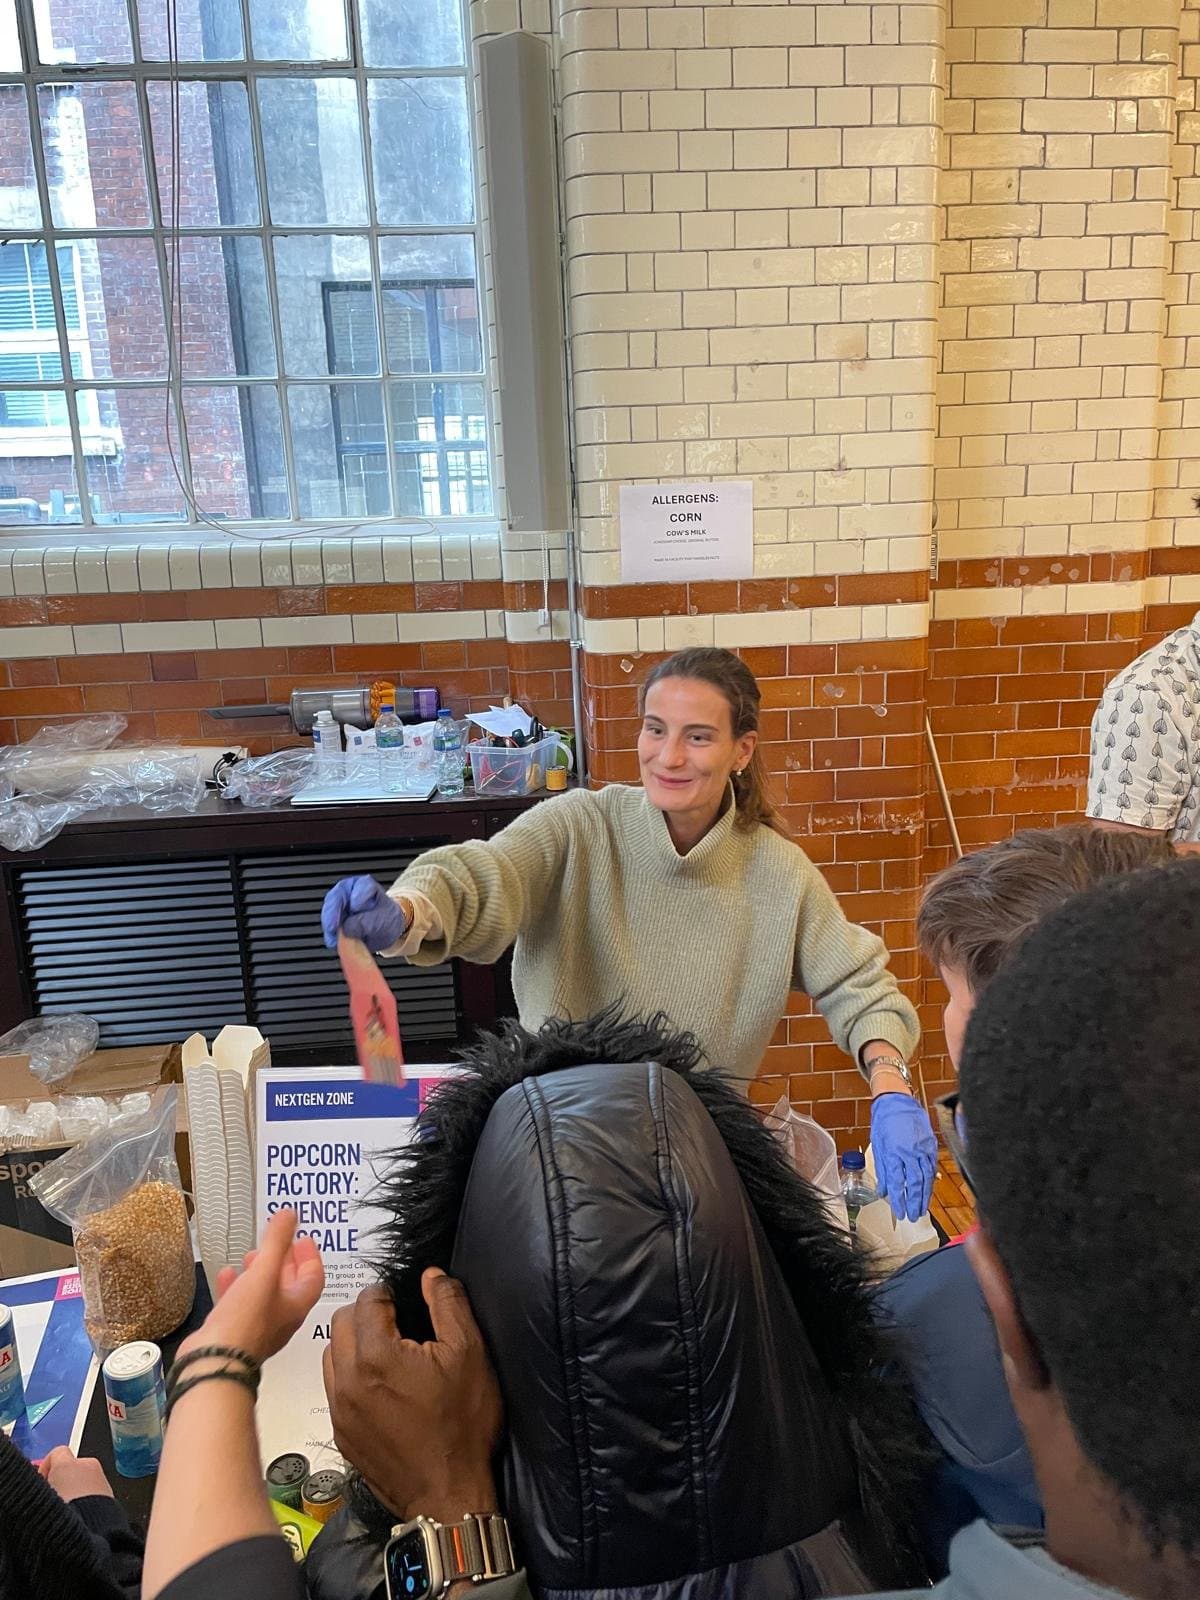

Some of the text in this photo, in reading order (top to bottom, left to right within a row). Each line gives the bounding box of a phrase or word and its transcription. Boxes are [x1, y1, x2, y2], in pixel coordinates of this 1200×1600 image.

[652, 494, 719, 505] ALLERGENS:
[669, 512, 702, 523] CORN
[275, 1091, 354, 1107] NEXTGEN ZONE
[267, 1142, 361, 1168] POPCORN
[0, 1160, 53, 1184] spo
[267, 1172, 359, 1196] FACTORY:
[312, 1324, 332, 1340] AL
